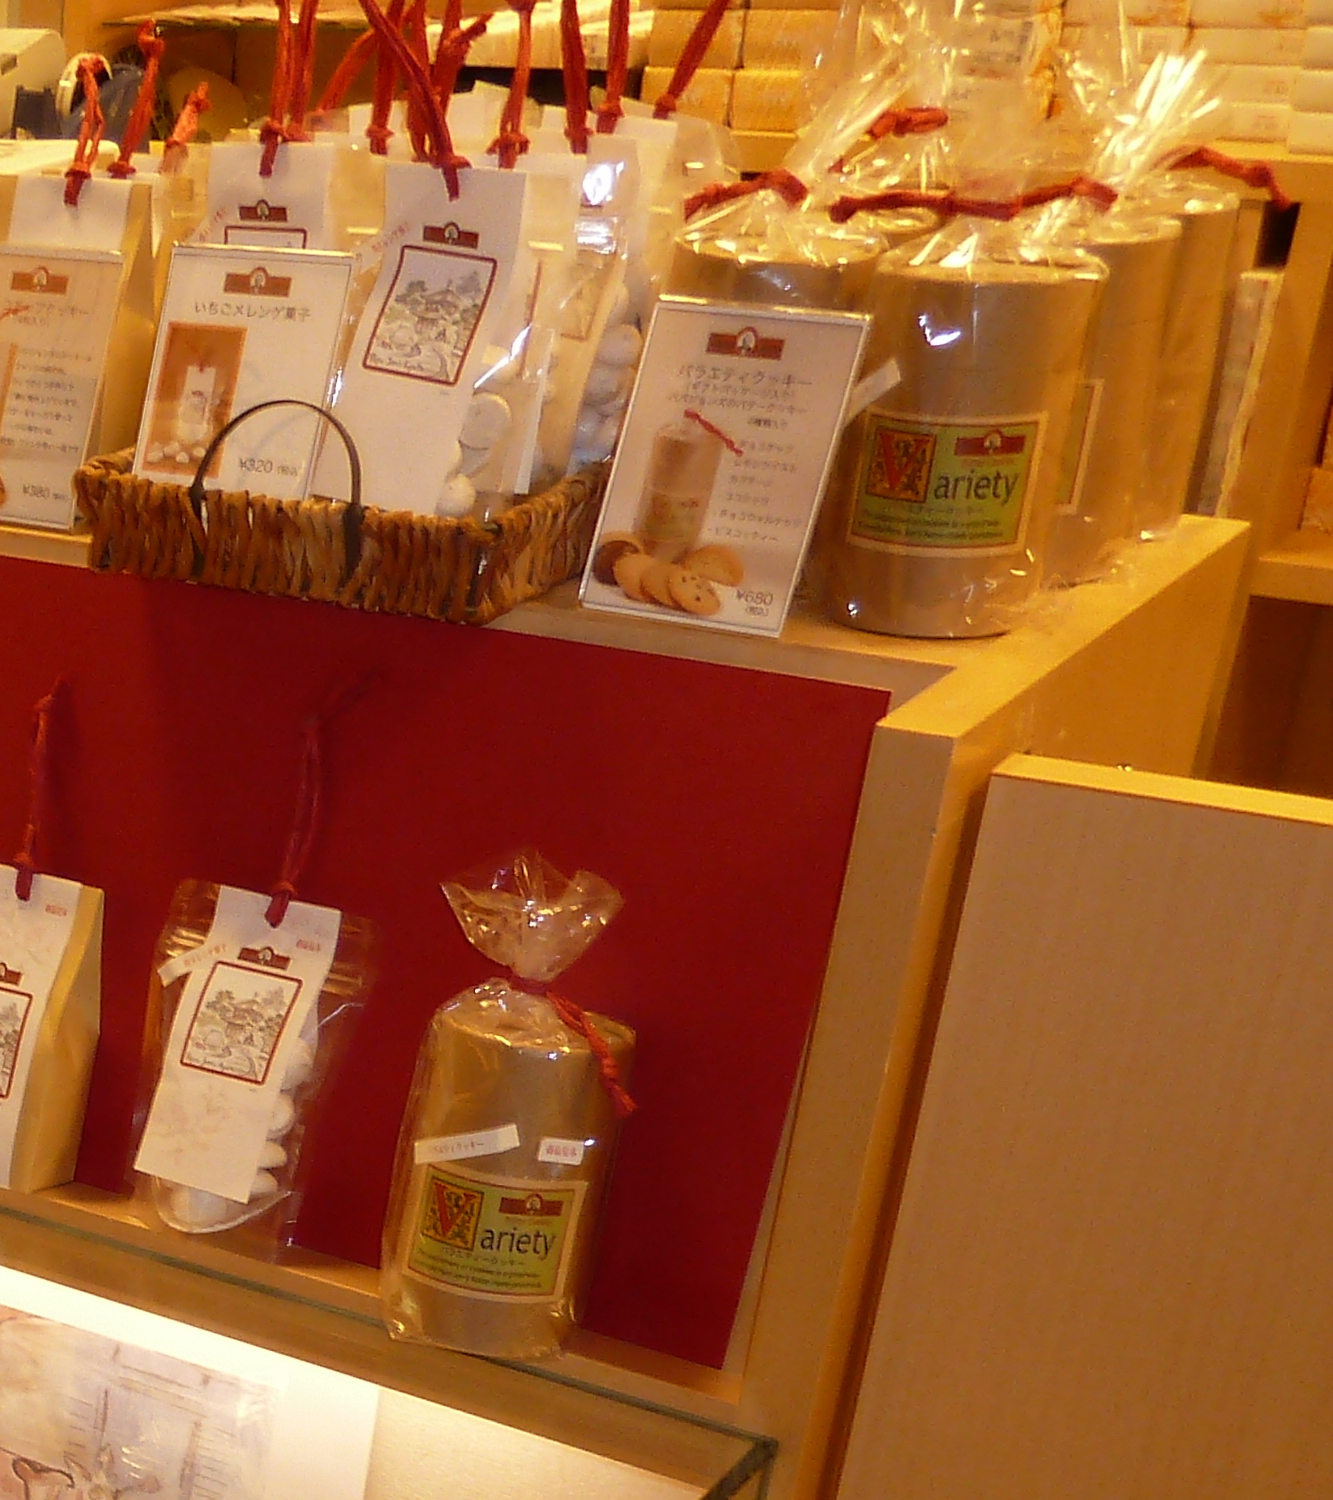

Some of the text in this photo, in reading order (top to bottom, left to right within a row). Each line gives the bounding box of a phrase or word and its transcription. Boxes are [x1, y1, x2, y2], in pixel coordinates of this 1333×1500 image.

[195, 301, 312, 322] いちごメレンゲ菓子
